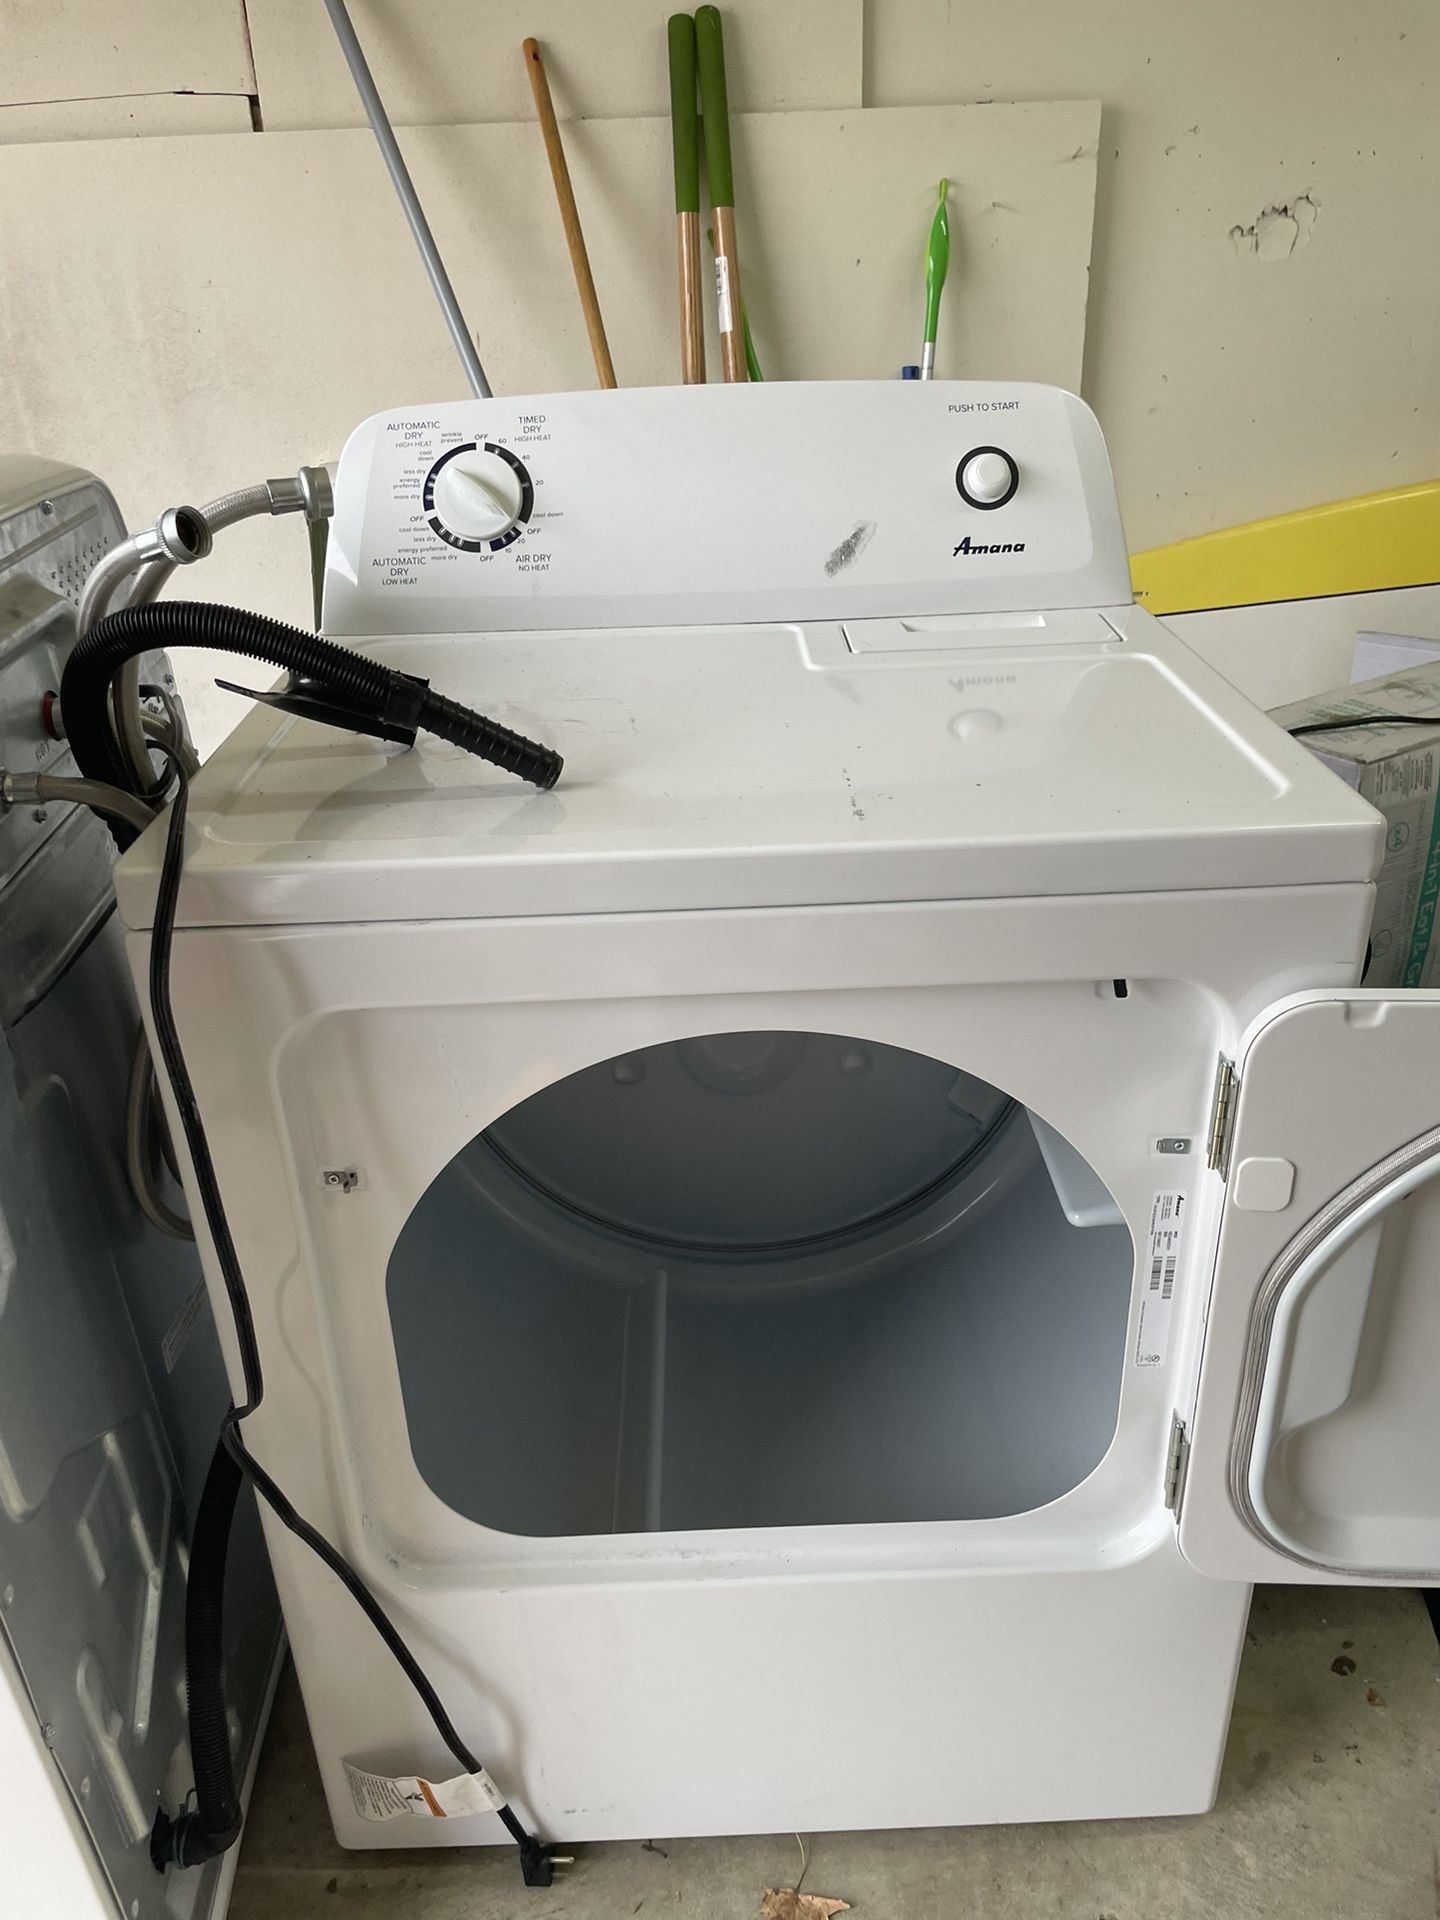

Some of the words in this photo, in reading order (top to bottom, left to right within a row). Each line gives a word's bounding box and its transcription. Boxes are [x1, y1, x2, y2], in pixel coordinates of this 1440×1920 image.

[948, 404, 974, 413] PUSH
[977, 403, 989, 411] TO
[991, 401, 1020, 411] START
[518, 415, 546, 424] TIMED
[387, 421, 440, 431] AUTOMATIC
[523, 425, 542, 434] DRY
[404, 431, 424, 440] DRY
[952, 536, 1025, 557] Amana
[372, 557, 426, 566] AUTOMATIC
[515, 554, 531, 563] AIR
[532, 553, 552, 562] DRY
[390, 567, 409, 576] DRY
[1416, 901, 1434, 935] Eat
